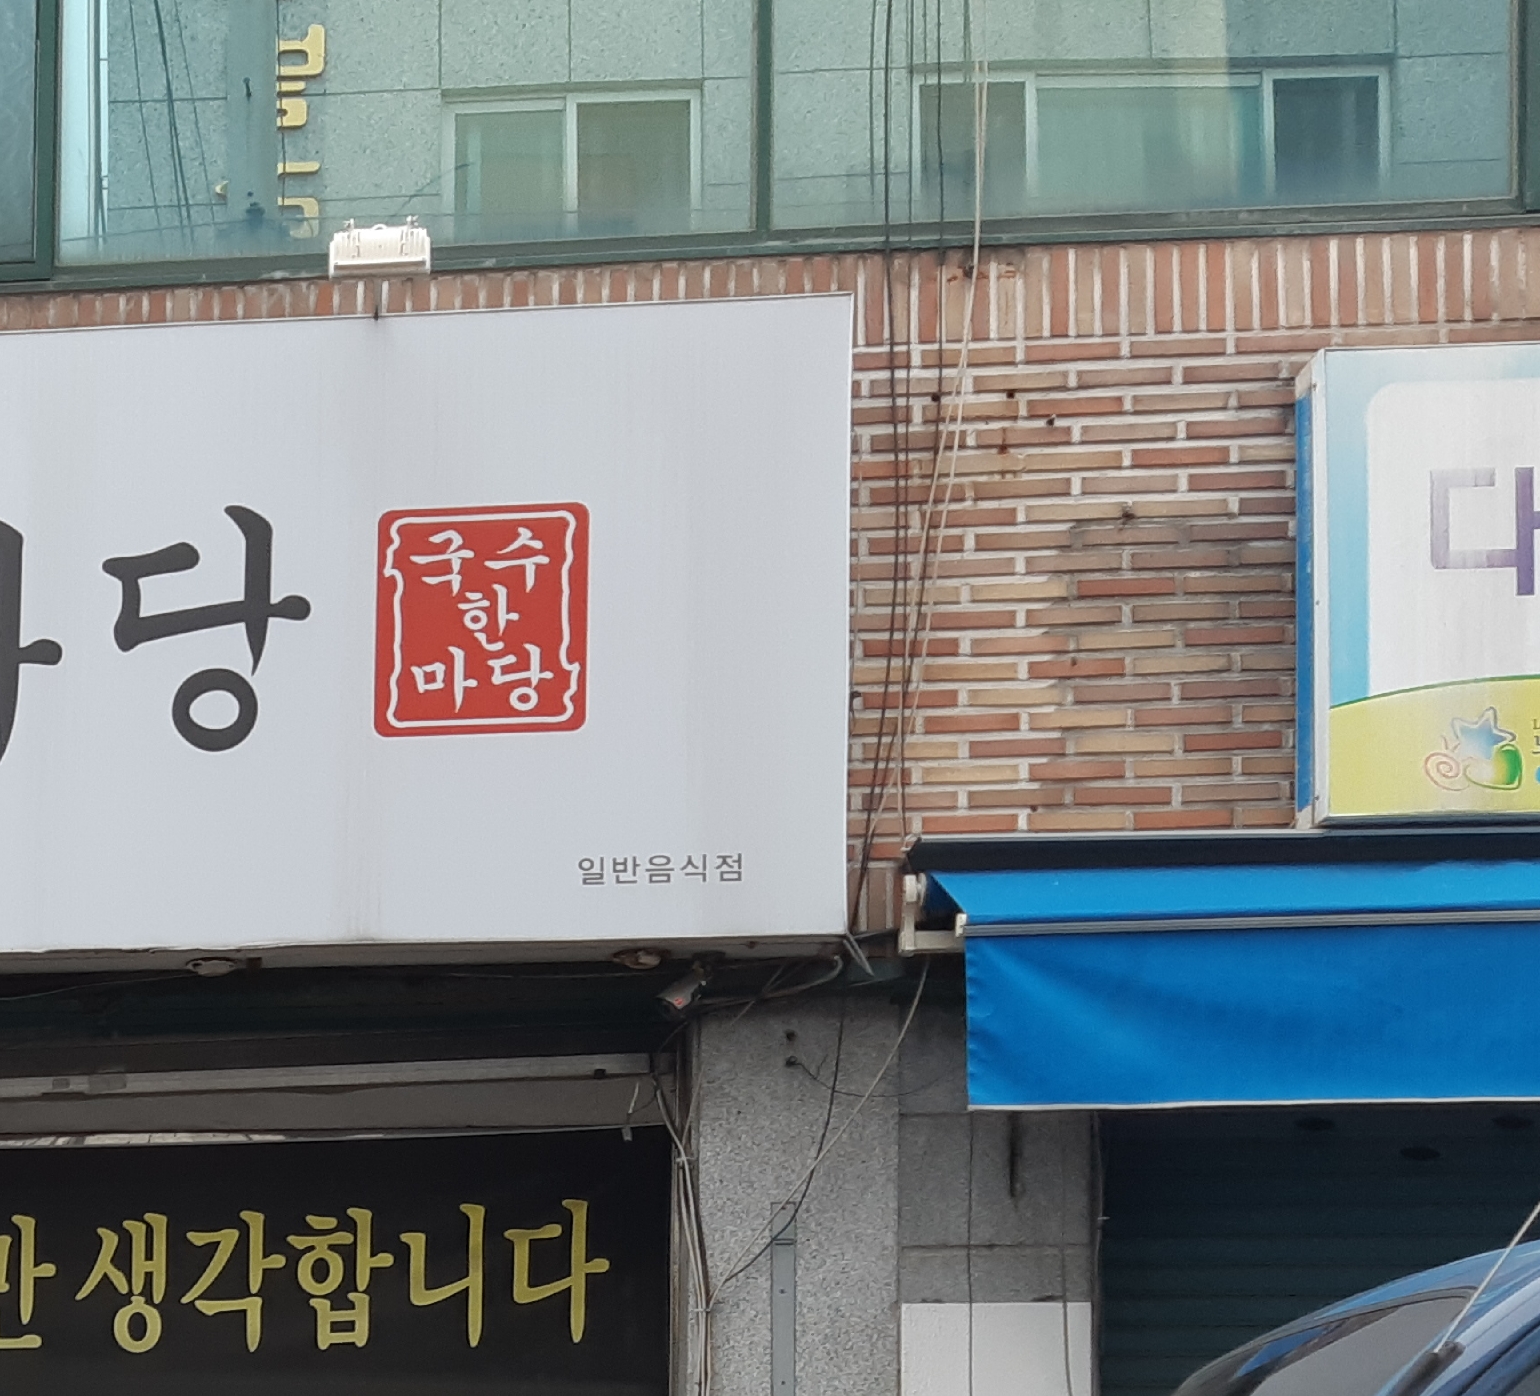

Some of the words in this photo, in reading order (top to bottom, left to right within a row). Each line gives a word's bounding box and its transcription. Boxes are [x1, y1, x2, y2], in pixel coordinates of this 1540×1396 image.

[409, 526, 551, 597] 국수
[457, 582, 520, 652] 한
[410, 642, 554, 715] 마당
[579, 853, 742, 885] 일반음식점
[74, 1199, 611, 1354] 생각합니다
